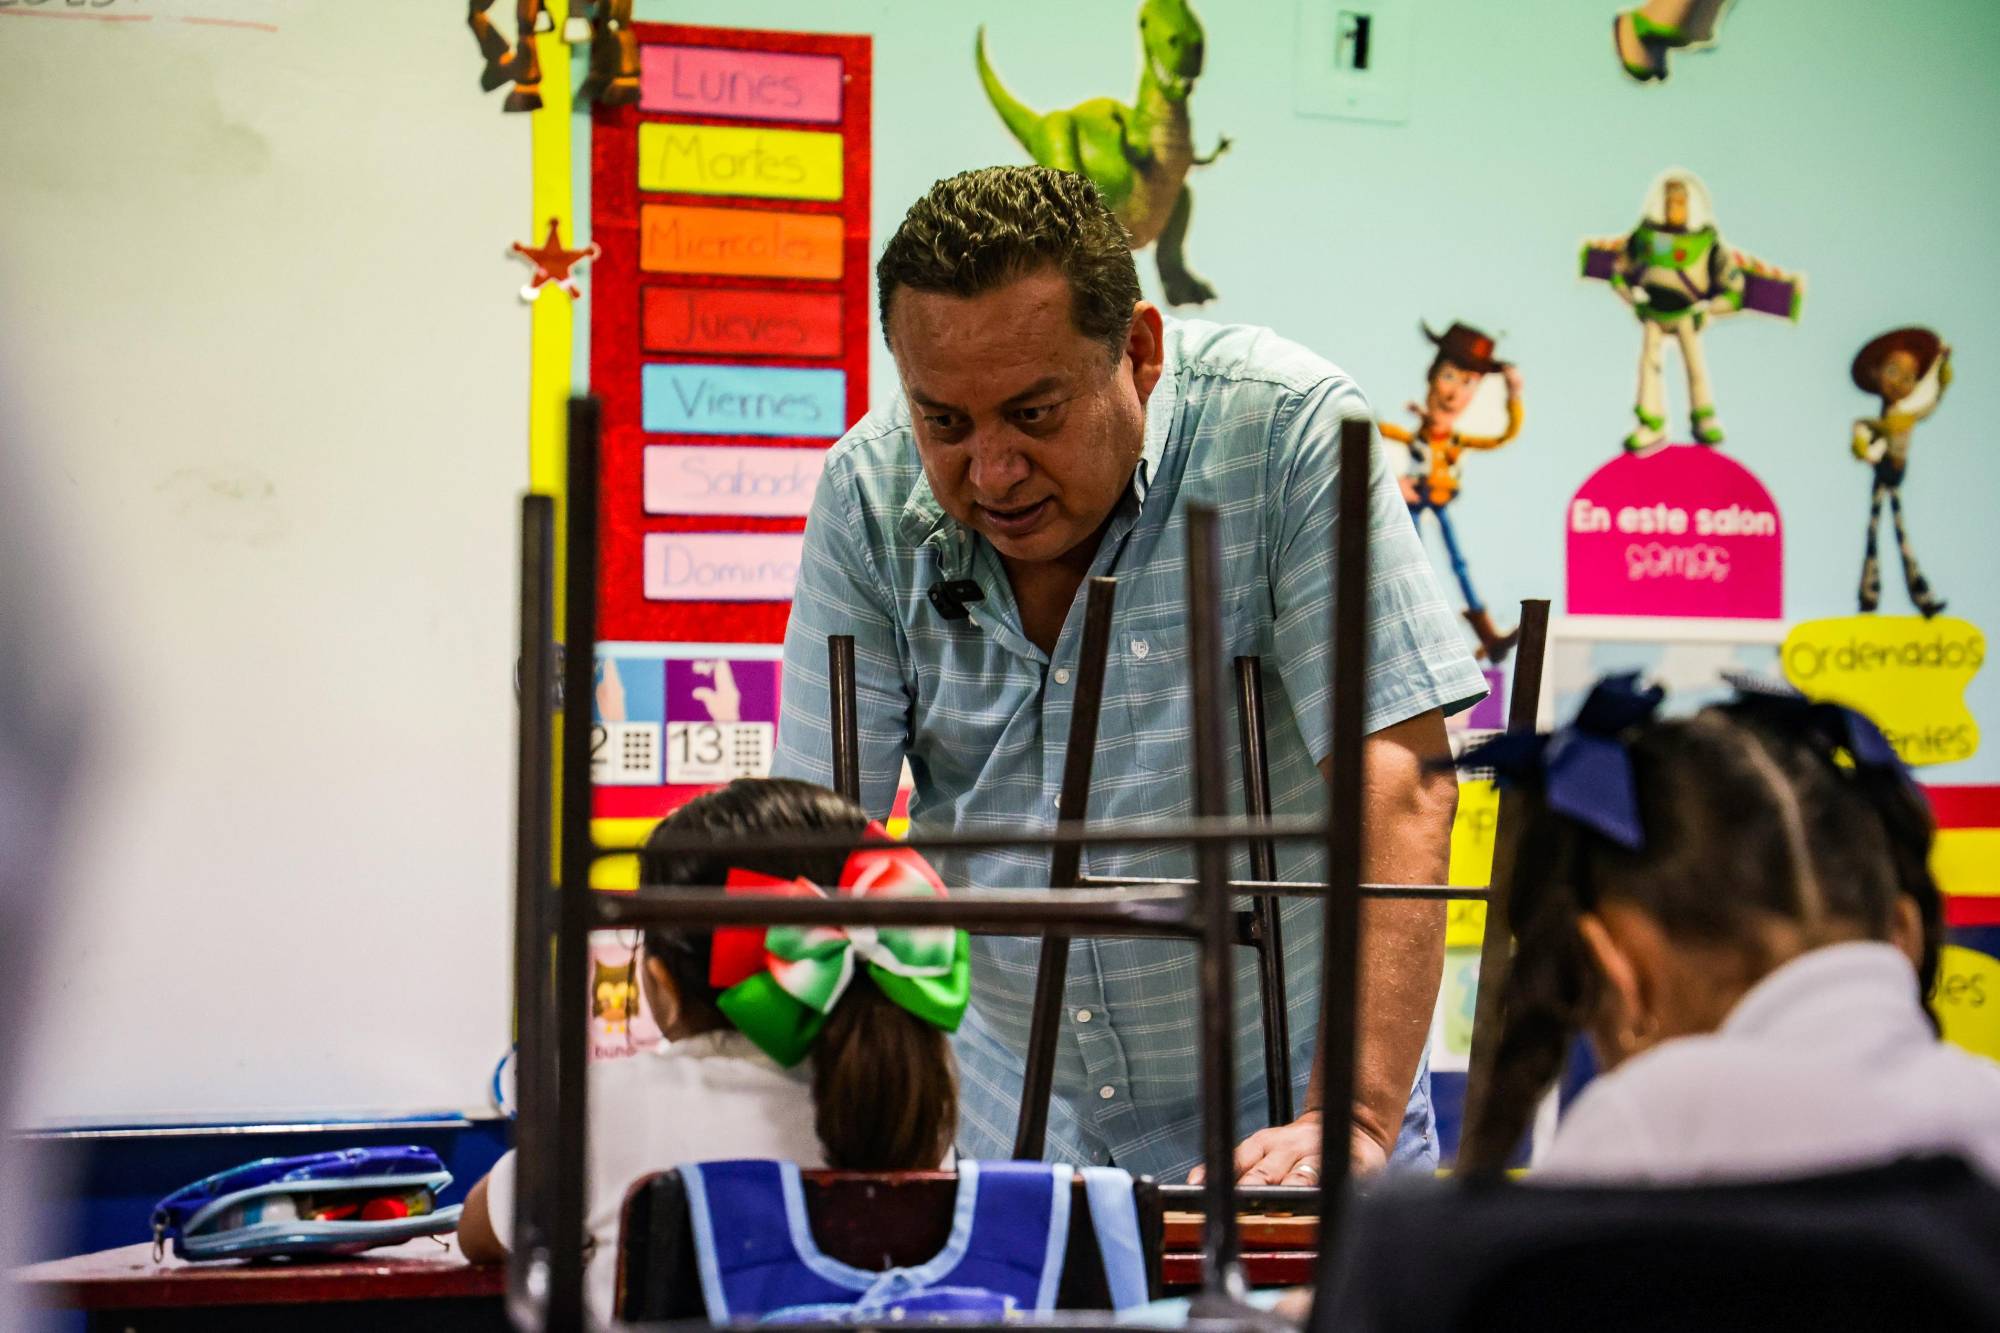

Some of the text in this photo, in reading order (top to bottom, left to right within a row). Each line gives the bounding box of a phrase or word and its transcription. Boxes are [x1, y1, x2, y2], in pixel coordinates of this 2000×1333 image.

[672, 54, 802, 107] Lunes
[658, 133, 807, 184] Martes
[675, 291, 806, 344] Jueves
[671, 374, 823, 421] Viernes
[1572, 499, 1611, 533] En
[1616, 502, 1689, 535] este
[1788, 633, 1985, 680] Ordenados
[670, 722, 724, 765] 13
